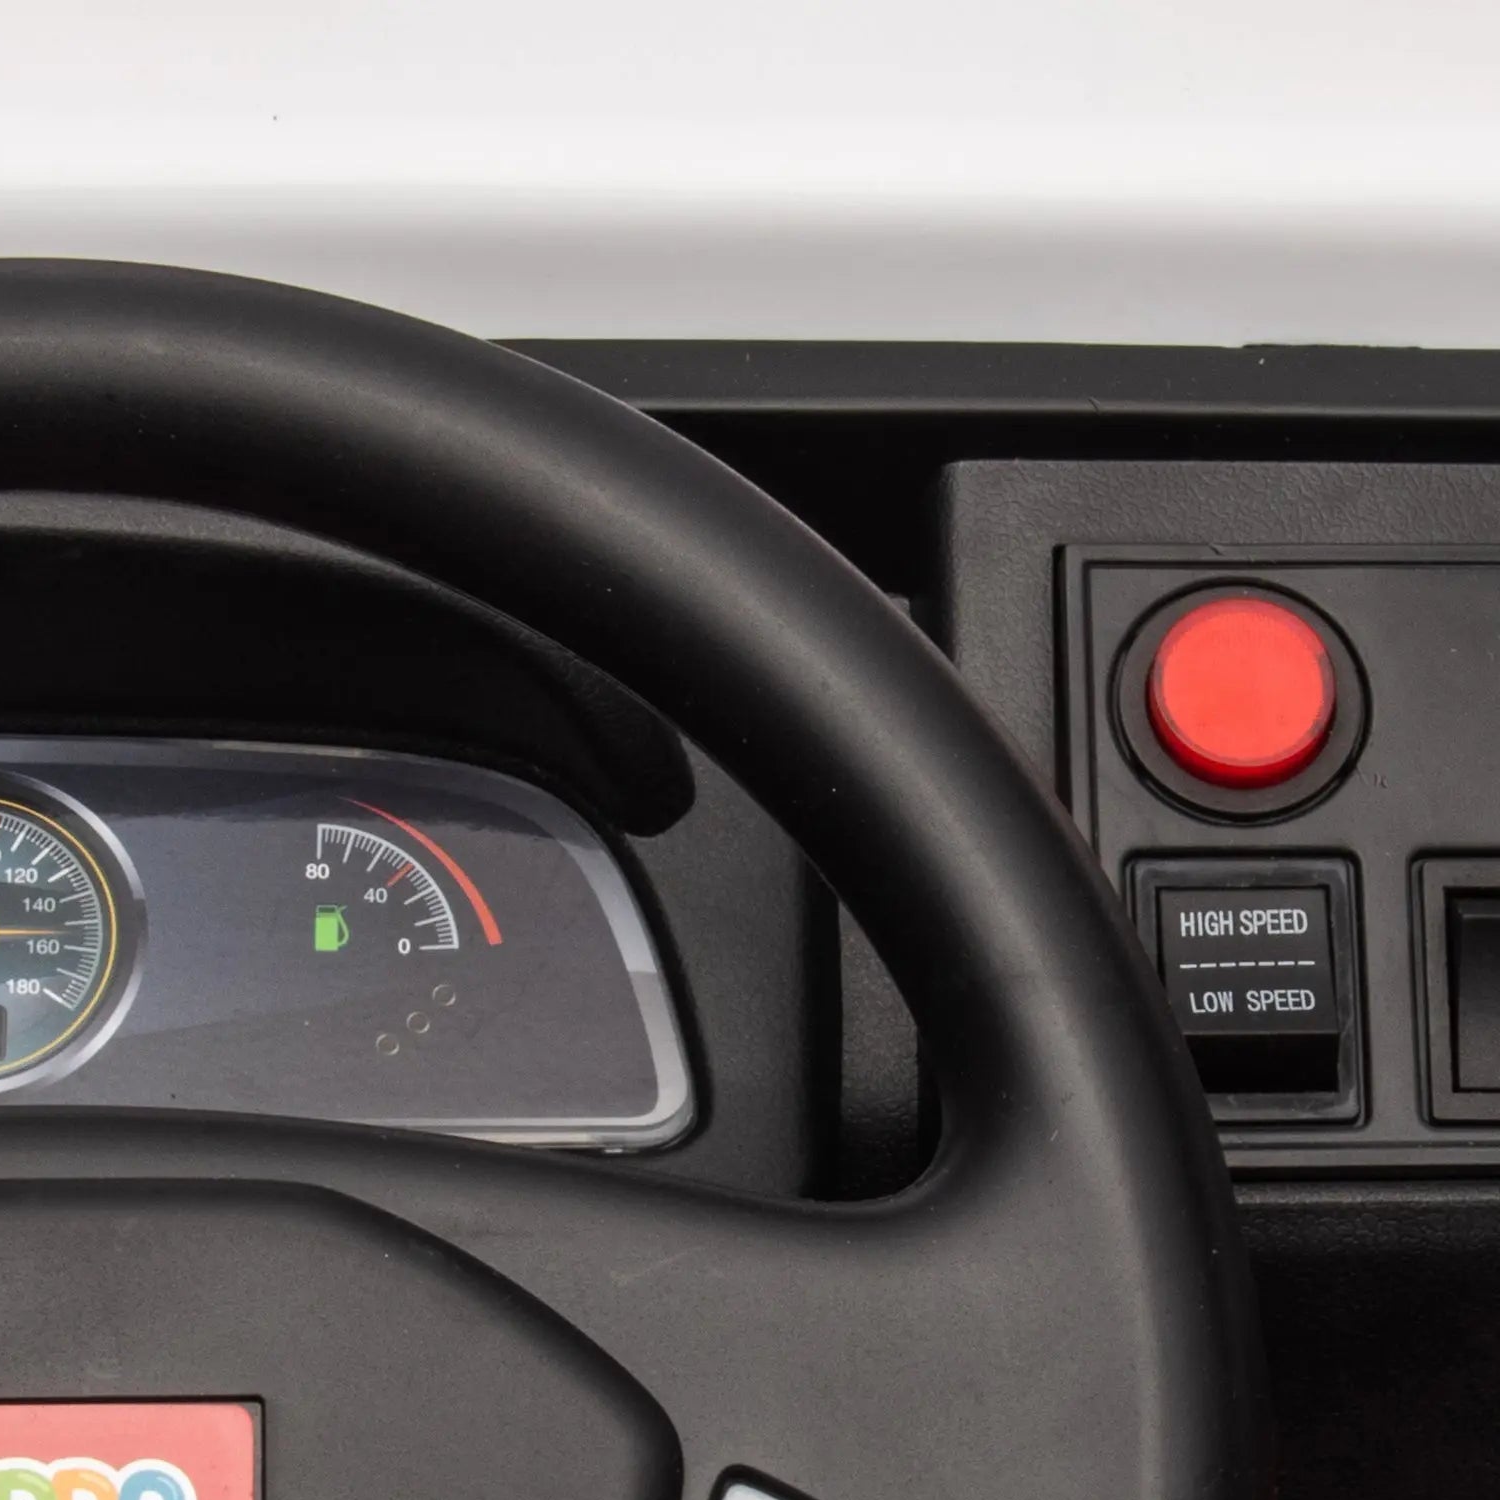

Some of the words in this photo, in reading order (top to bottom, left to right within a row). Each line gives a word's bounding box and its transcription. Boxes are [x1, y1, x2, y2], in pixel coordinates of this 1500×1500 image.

[4, 868, 38, 883] 120
[305, 863, 330, 879] 80
[364, 888, 388, 903] 40
[23, 898, 56, 913] 140
[1180, 911, 1234, 937] HIGH
[1239, 909, 1308, 935] SPEED
[27, 940, 60, 955] 160
[397, 938, 411, 955] 0
[6, 979, 40, 994] 180
[1190, 991, 1234, 1013] LOW
[1246, 989, 1315, 1011] SPEED
